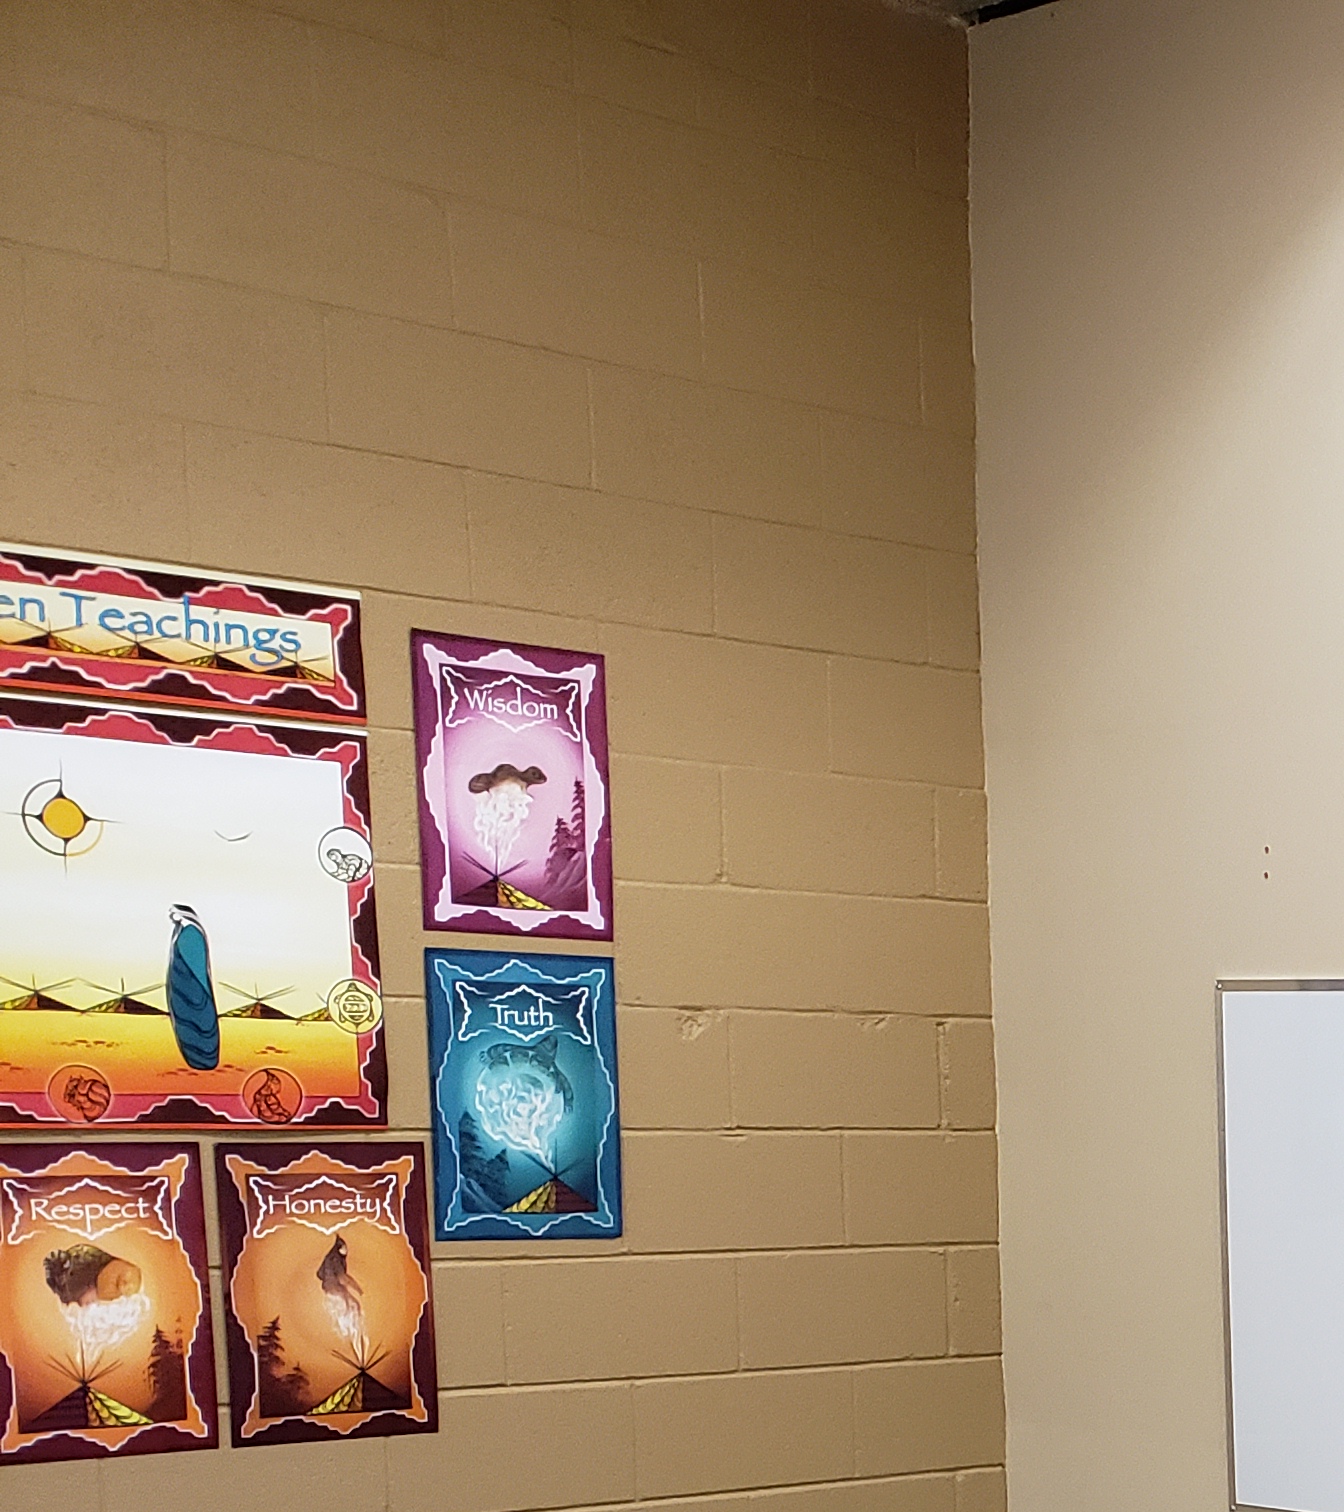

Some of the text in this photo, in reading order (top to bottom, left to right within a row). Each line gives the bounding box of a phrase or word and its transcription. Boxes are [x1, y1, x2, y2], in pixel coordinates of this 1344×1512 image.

[59, 591, 301, 666] Teachings
[464, 686, 558, 721] Wisdom
[489, 1003, 555, 1029] Truth
[31, 1196, 150, 1227] Respect
[268, 1192, 382, 1221] Honesty
